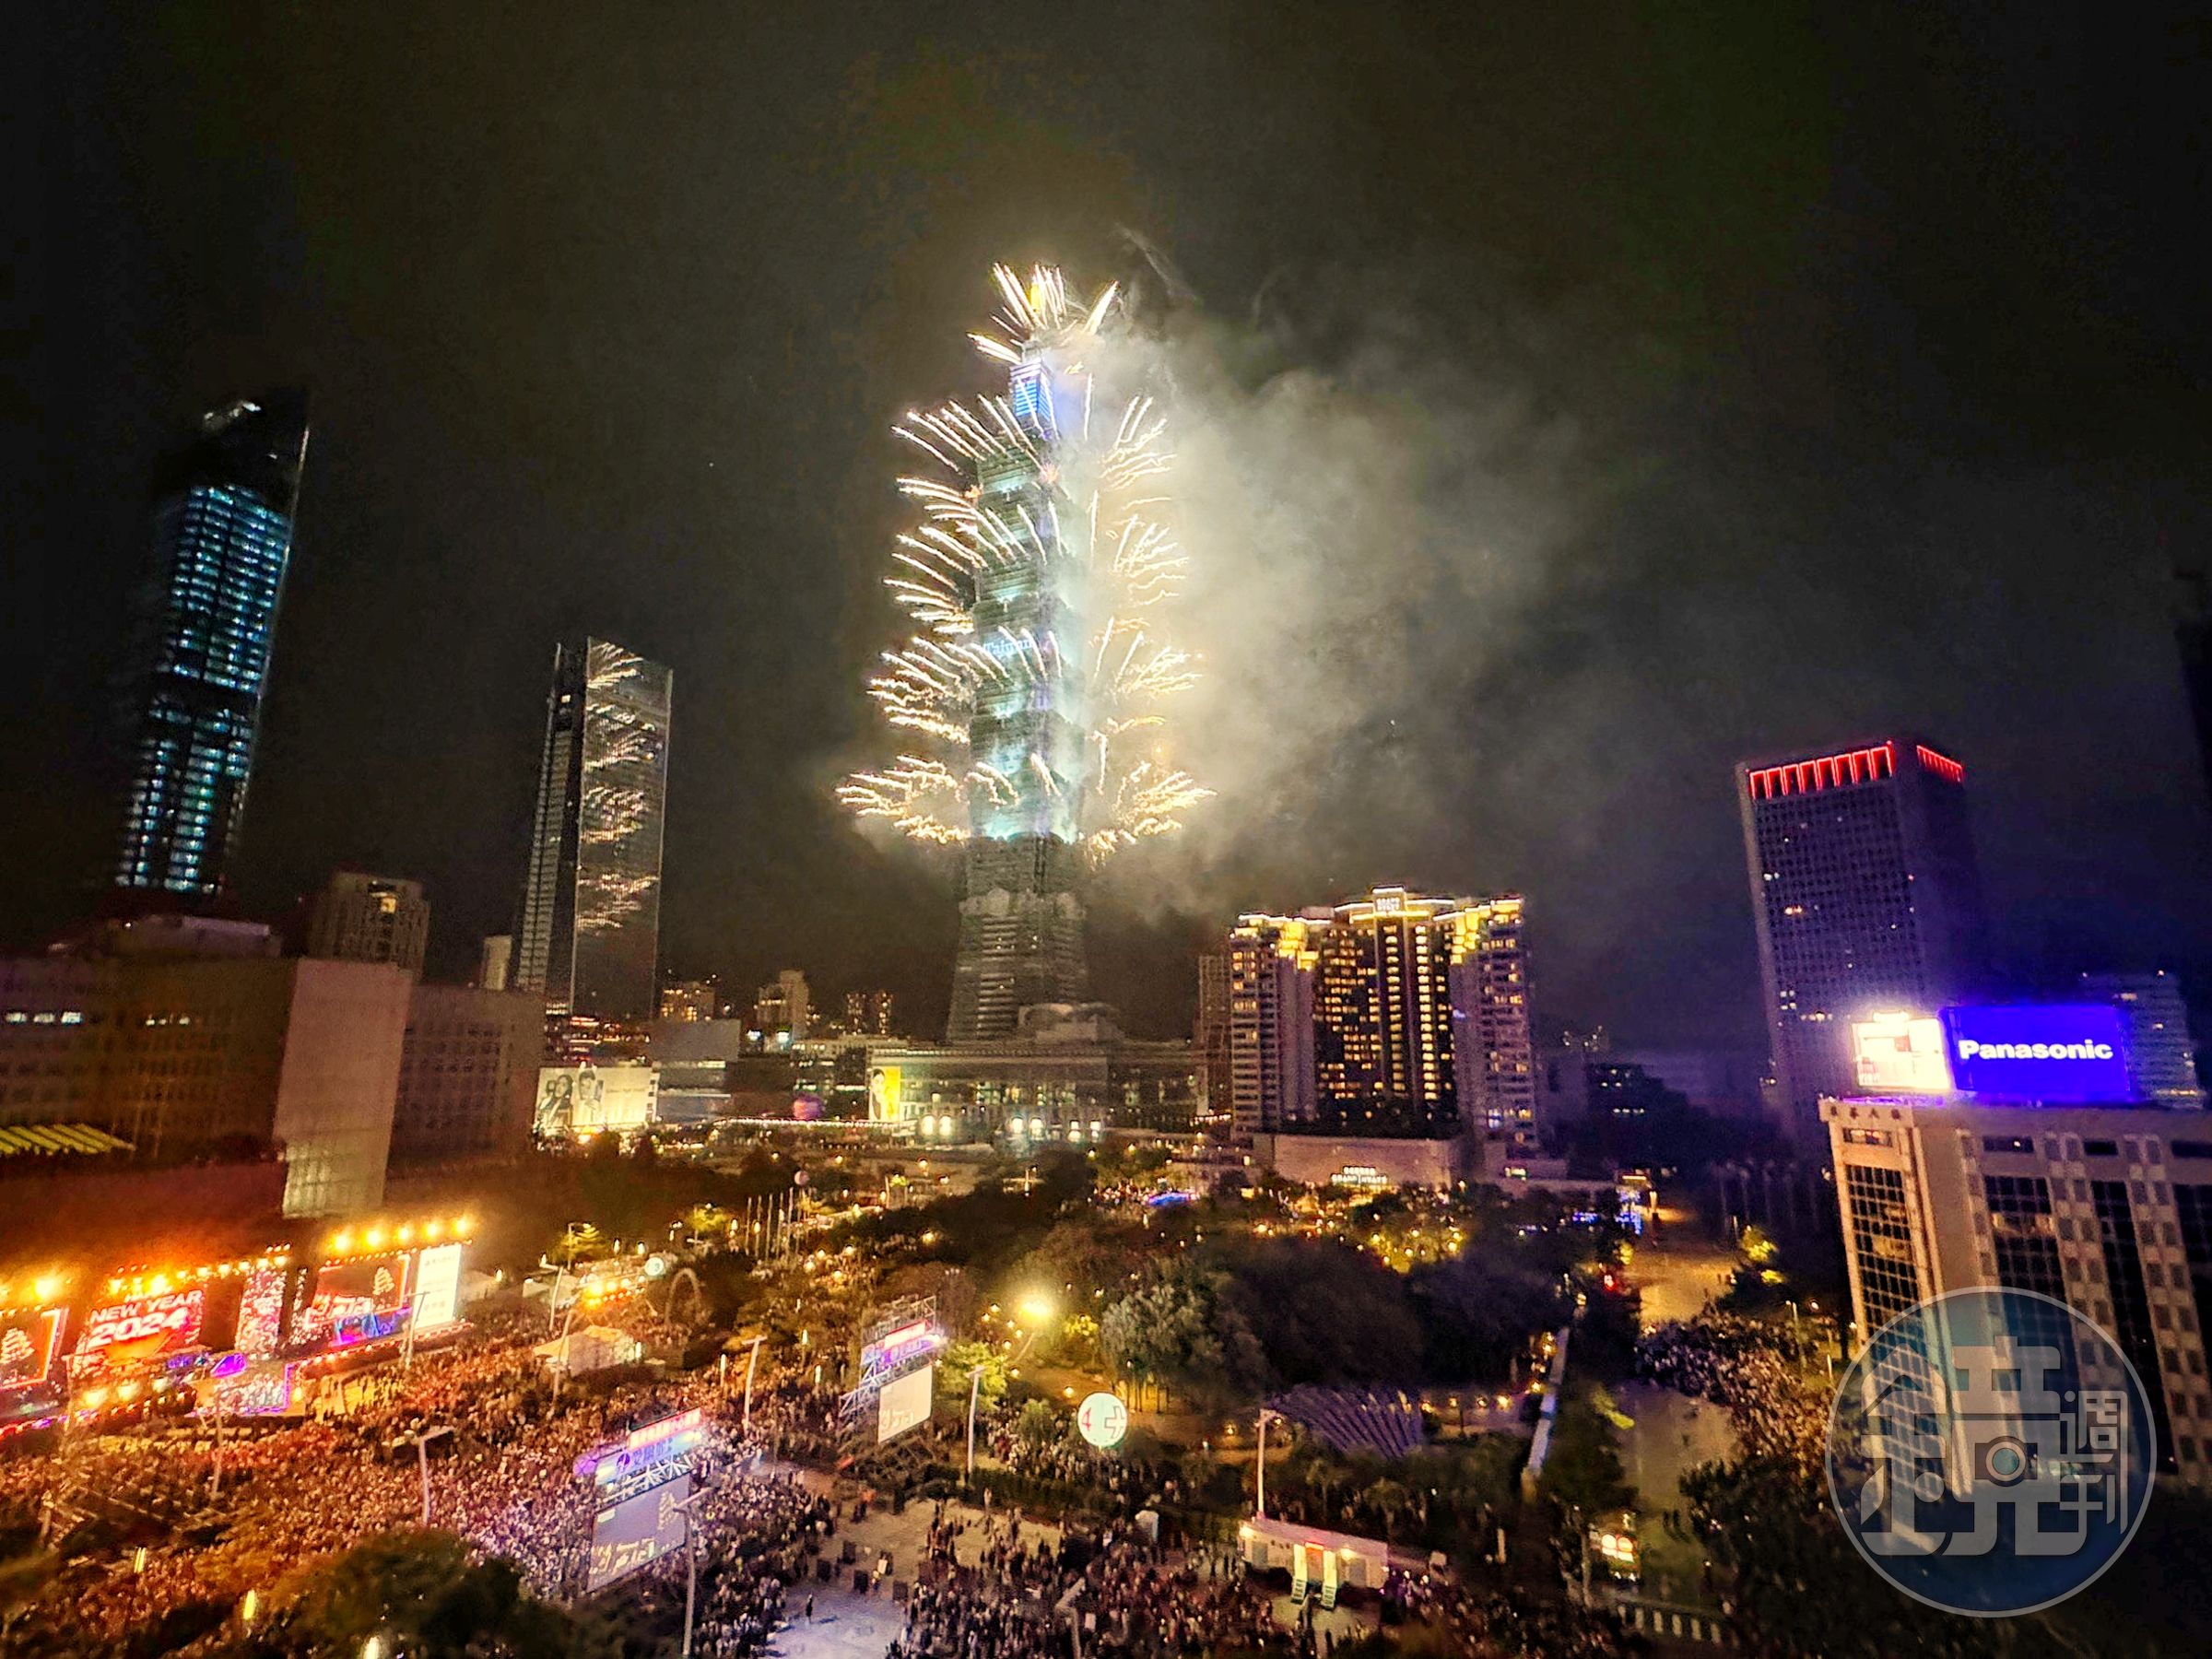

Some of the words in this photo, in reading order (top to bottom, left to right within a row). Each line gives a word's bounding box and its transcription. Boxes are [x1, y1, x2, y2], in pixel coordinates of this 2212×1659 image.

[1959, 1039, 2113, 1060] Panasonic
[90, 1301, 141, 1324] NEW
[147, 1289, 203, 1312] YEAR
[87, 1307, 189, 1348] 2024
[1082, 1407, 1092, 1431] 4
